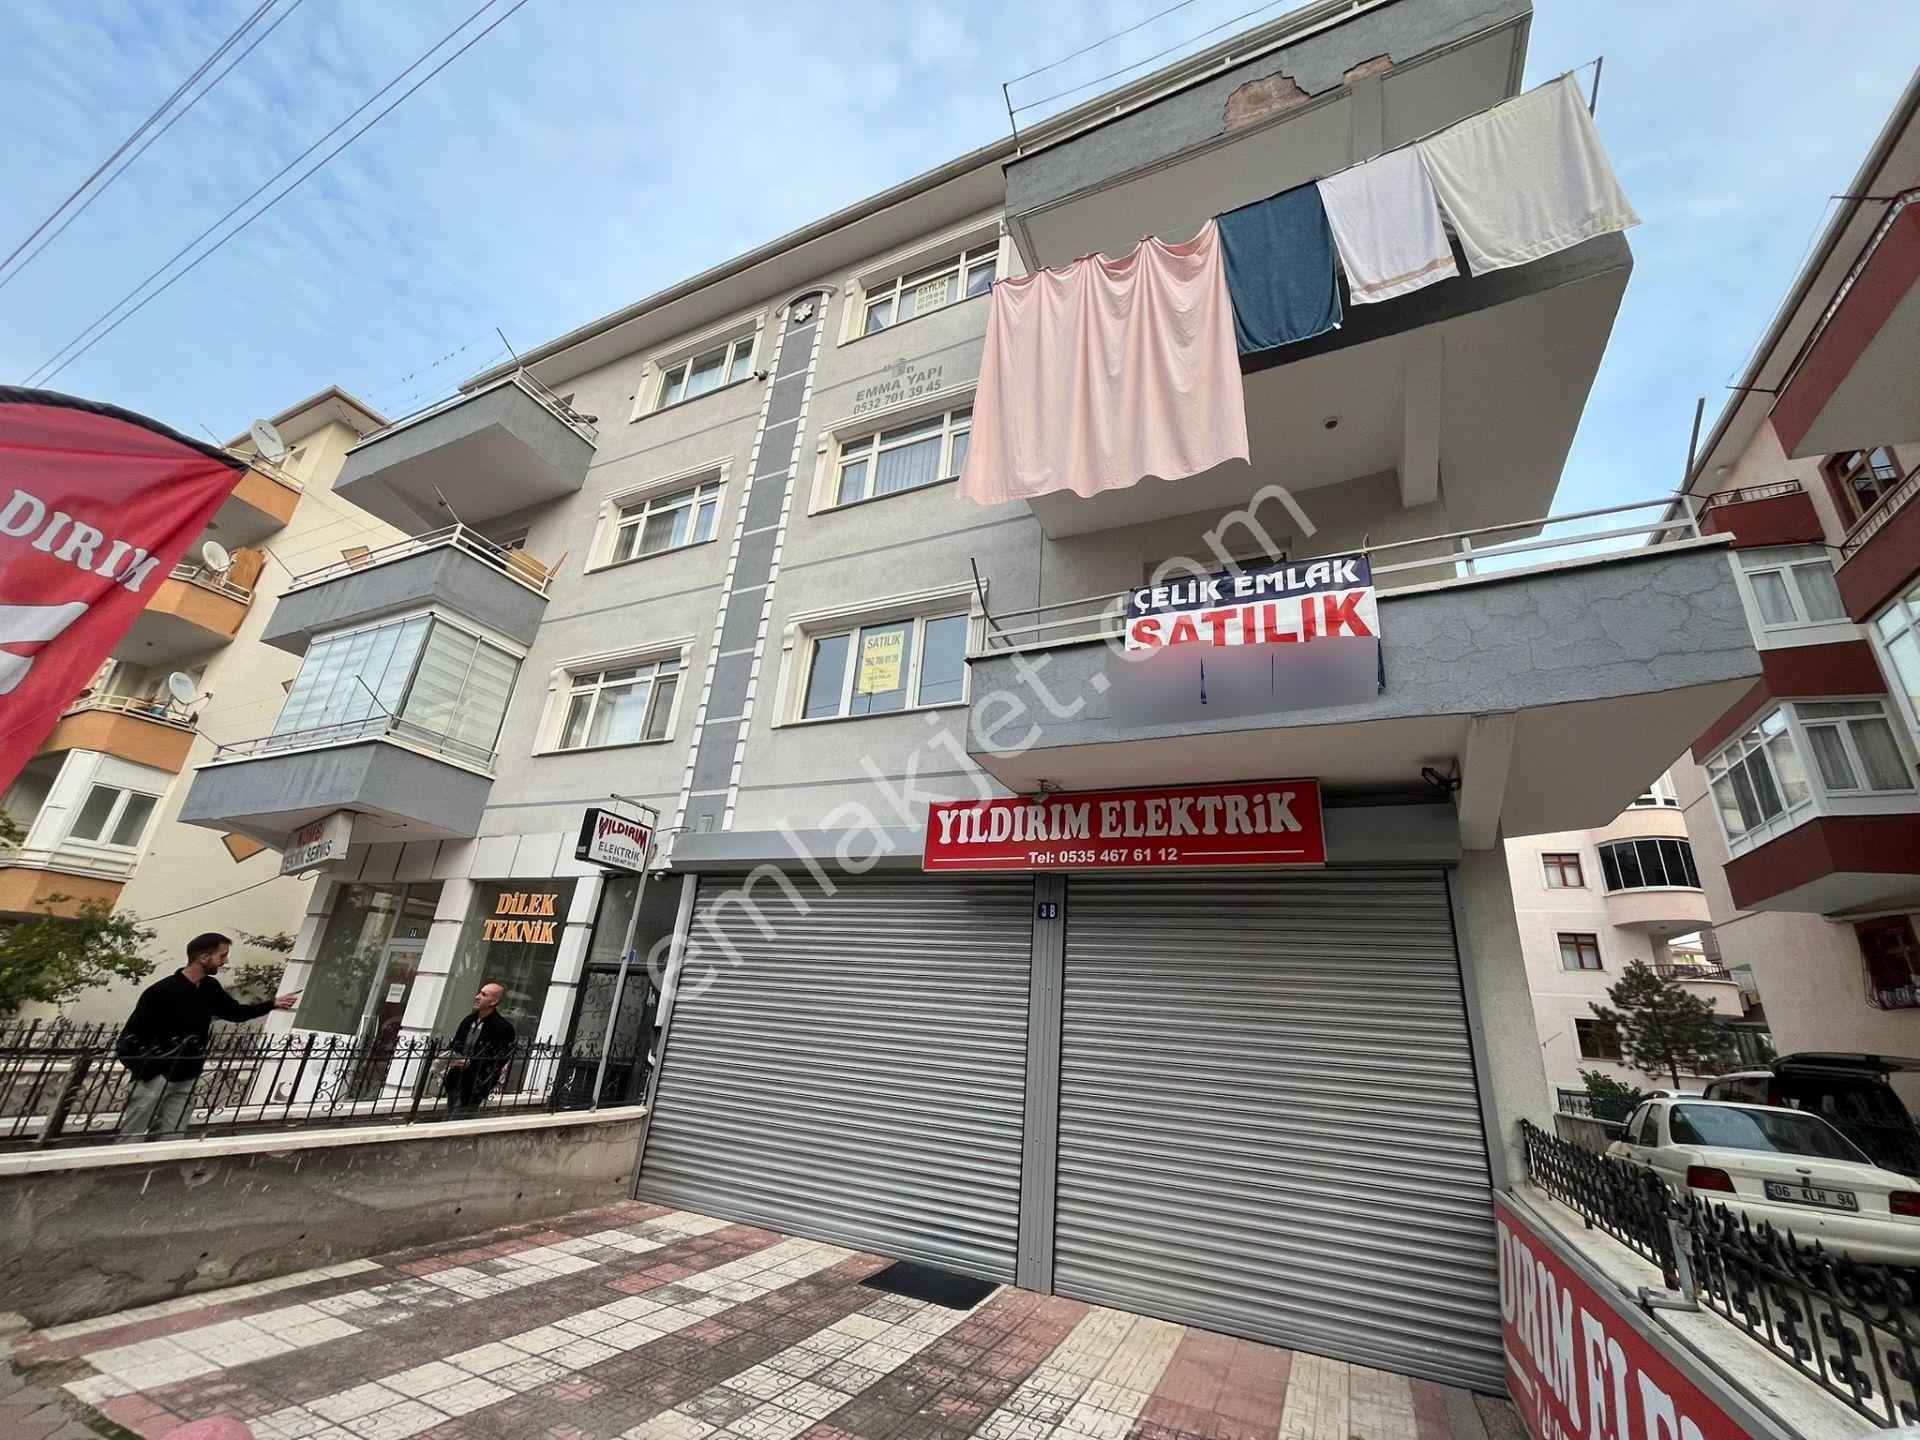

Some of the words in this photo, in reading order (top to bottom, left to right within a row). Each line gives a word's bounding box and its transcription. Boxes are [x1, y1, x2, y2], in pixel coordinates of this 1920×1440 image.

[854, 397, 881, 415] 0532
[885, 390, 905, 406] 701
[908, 385, 924, 398] 39
[926, 379, 941, 392] 45
[856, 379, 901, 402] EMMA
[907, 365, 943, 386] YAPI
[1134, 578, 1224, 615] ÇELİK
[1234, 559, 1360, 598] EMLAK
[867, 633, 902, 649] SATILIK
[598, 816, 648, 856] YILDIRIM
[937, 797, 1091, 845] YILDIRIM
[1029, 851, 1055, 864] Tel:
[1058, 849, 1096, 863] 0535
[1100, 848, 1128, 862] 467
[1133, 848, 1153, 861] 61
[1158, 847, 1178, 861] 12
[1774, 1184, 1791, 1198] 06
[1801, 1188, 1826, 1203] KLH
[1497, 1219, 1582, 1432] DIRIM
